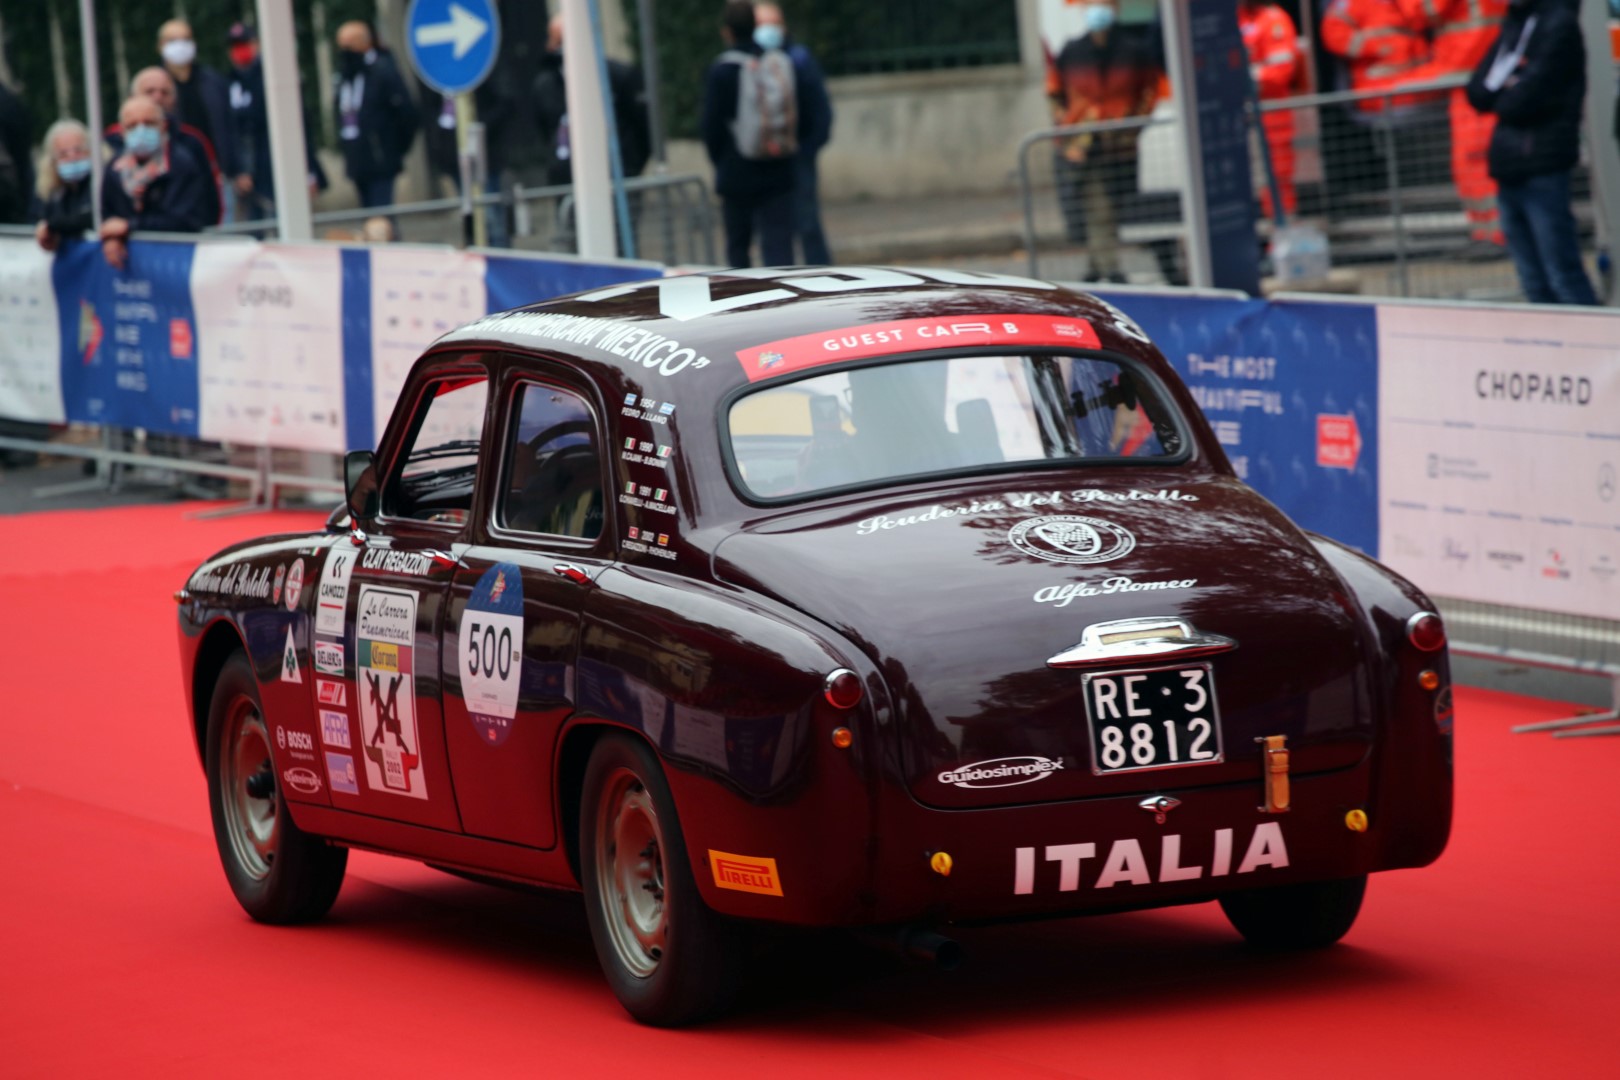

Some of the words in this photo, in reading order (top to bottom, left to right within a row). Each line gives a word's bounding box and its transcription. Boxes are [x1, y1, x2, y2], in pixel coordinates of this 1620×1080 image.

[823, 329, 903, 352] GUEST
[917, 321, 992, 339] CAR
[1002, 322, 1020, 335] B
[1232, 356, 1277, 381] MOST
[1475, 369, 1592, 406] CHOPARD
[856, 501, 1005, 535] Scuderia
[1012, 491, 1063, 508] del
[1072, 489, 1199, 503] Portello
[362, 548, 385, 569] CLAY
[382, 550, 435, 576] REGAZZONI
[1033, 582, 1103, 607] Alfa
[1101, 576, 1198, 595] Romeo
[365, 596, 377, 616] La
[378, 597, 409, 619] Carrera
[361, 616, 410, 642] Panamericana
[468, 622, 513, 681] 500
[1092, 674, 1151, 719] RE
[1180, 669, 1207, 713] 3
[287, 730, 313, 751] BOSCH
[1101, 717, 1214, 769] 8812
[937, 758, 1062, 784] Guidosimplex
[716, 858, 774, 889] PIRELLI
[1014, 822, 1290, 895] ITALIA
